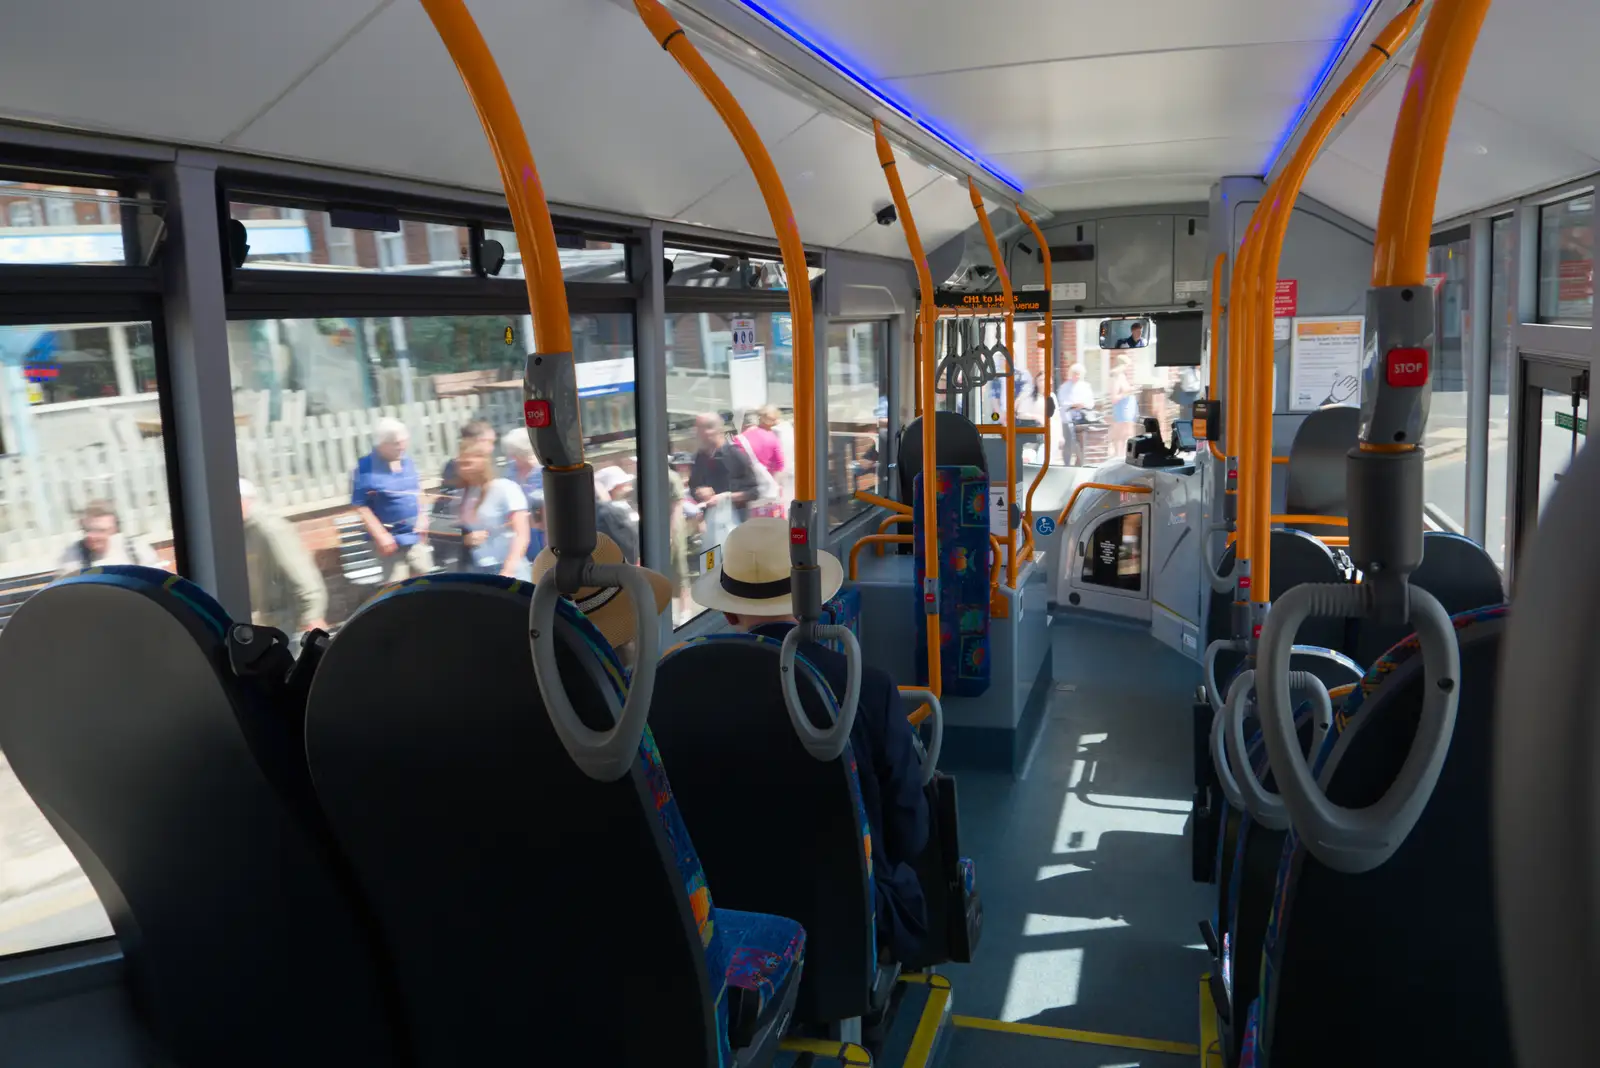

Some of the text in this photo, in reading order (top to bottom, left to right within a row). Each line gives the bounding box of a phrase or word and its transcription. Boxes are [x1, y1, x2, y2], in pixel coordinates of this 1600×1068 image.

[963, 295, 980, 303] CH1
[983, 295, 993, 303] to
[1014, 302, 1040, 310] venue
[1394, 363, 1423, 374] STOP
[527, 409, 545, 419] STOP
